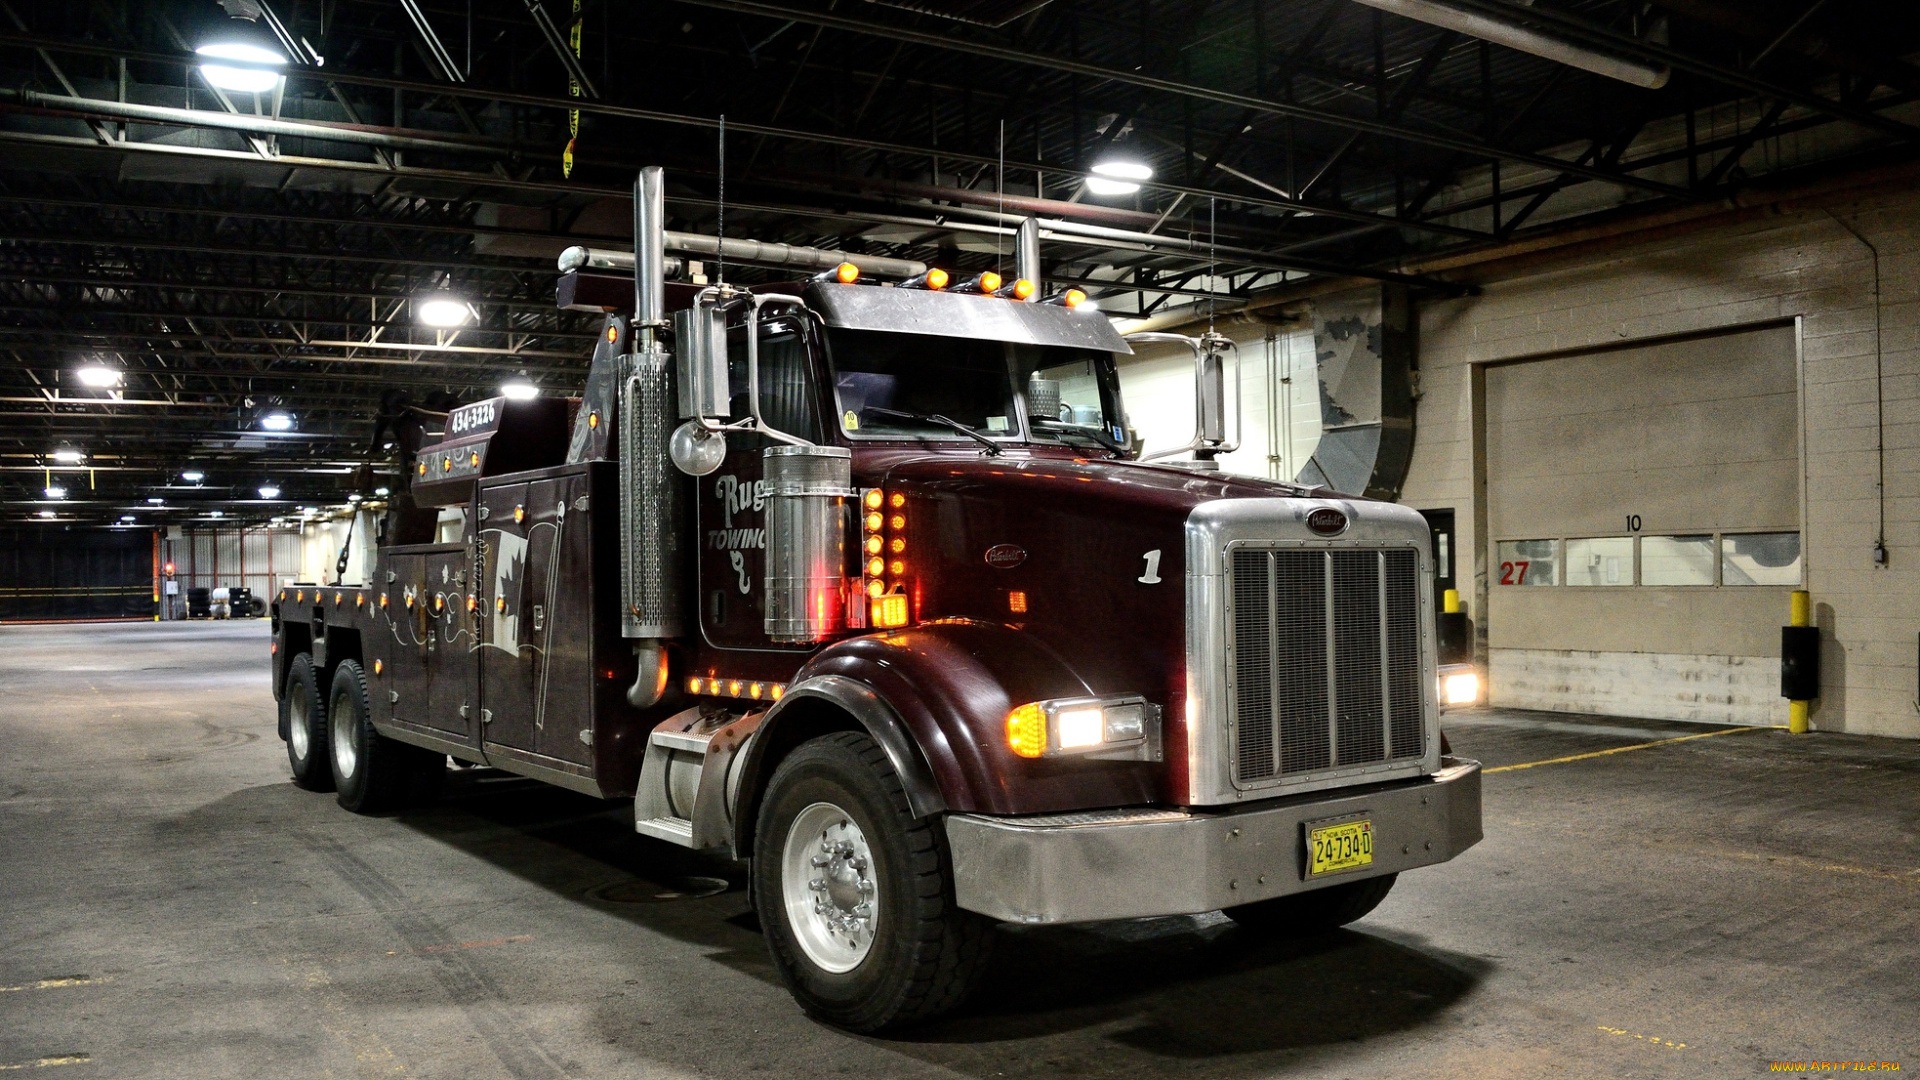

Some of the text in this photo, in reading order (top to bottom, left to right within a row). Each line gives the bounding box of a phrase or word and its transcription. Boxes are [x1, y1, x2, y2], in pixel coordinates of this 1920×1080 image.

[452, 402, 495, 433] 434-3226
[846, 412, 855, 421] 10
[1625, 514, 1642, 532] 10
[1137, 549, 1162, 585] 1
[1500, 561, 1529, 585] 27
